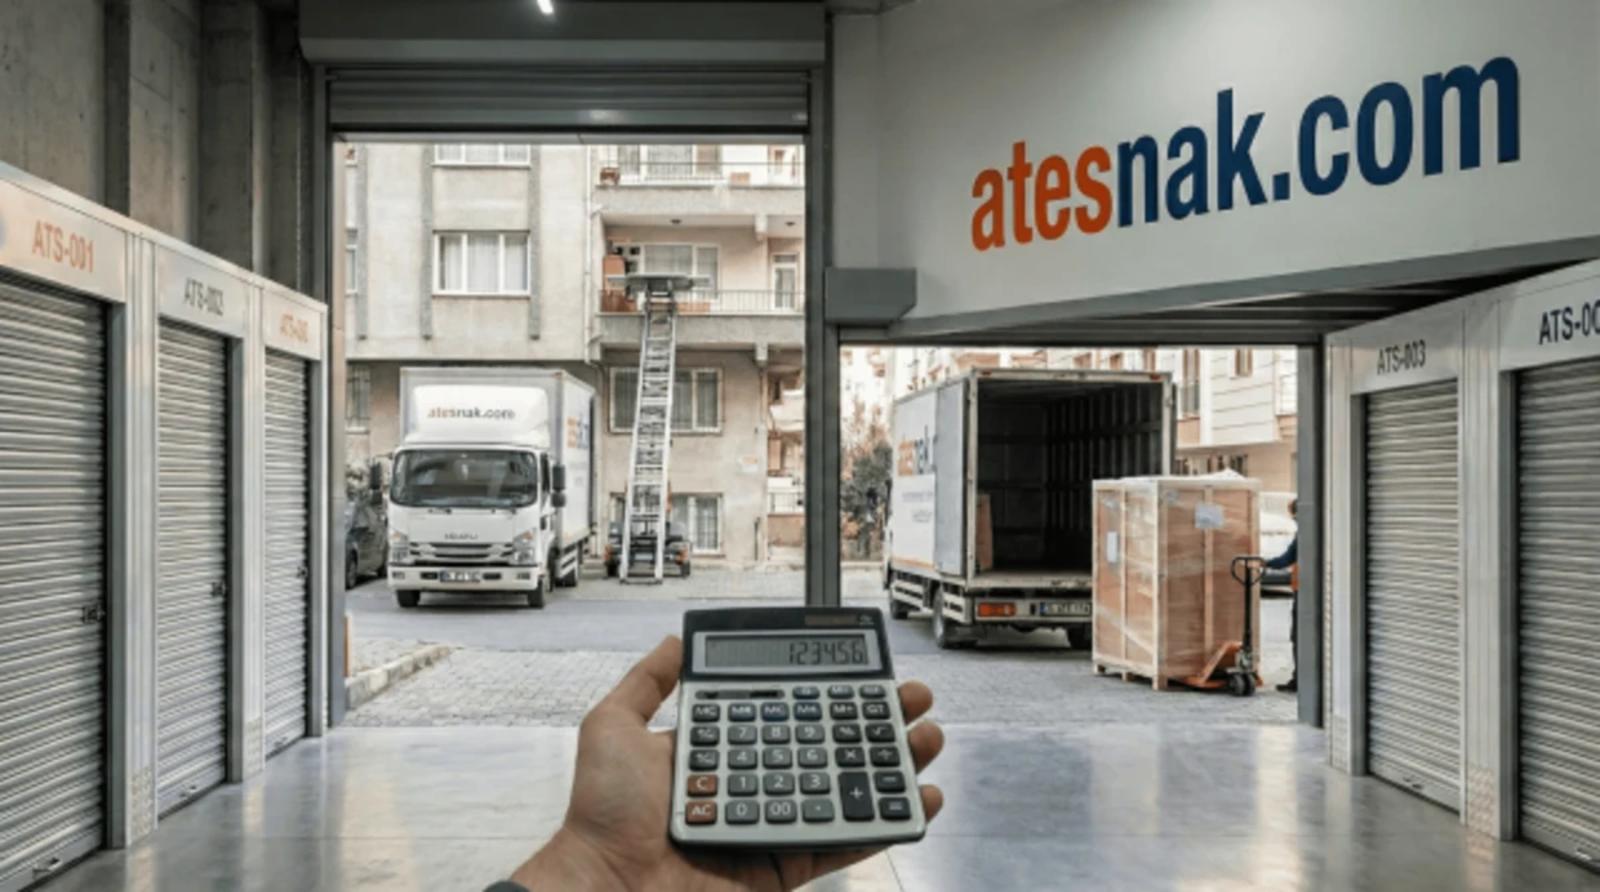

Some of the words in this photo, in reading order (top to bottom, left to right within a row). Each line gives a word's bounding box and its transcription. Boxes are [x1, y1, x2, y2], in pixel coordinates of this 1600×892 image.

[972, 57, 1520, 252] atesnak.com
[31, 219, 94, 274] ATS-001
[789, 641, 865, 666] 123456
[736, 750, 748, 762] 4
[772, 749, 784, 763] 5
[806, 748, 818, 761] 6
[696, 775, 709, 791] C
[773, 774, 784, 789] 2
[810, 773, 821, 789] 3
[691, 803, 712, 817] AC
[735, 801, 748, 817] 0
[769, 801, 791, 816] 00
